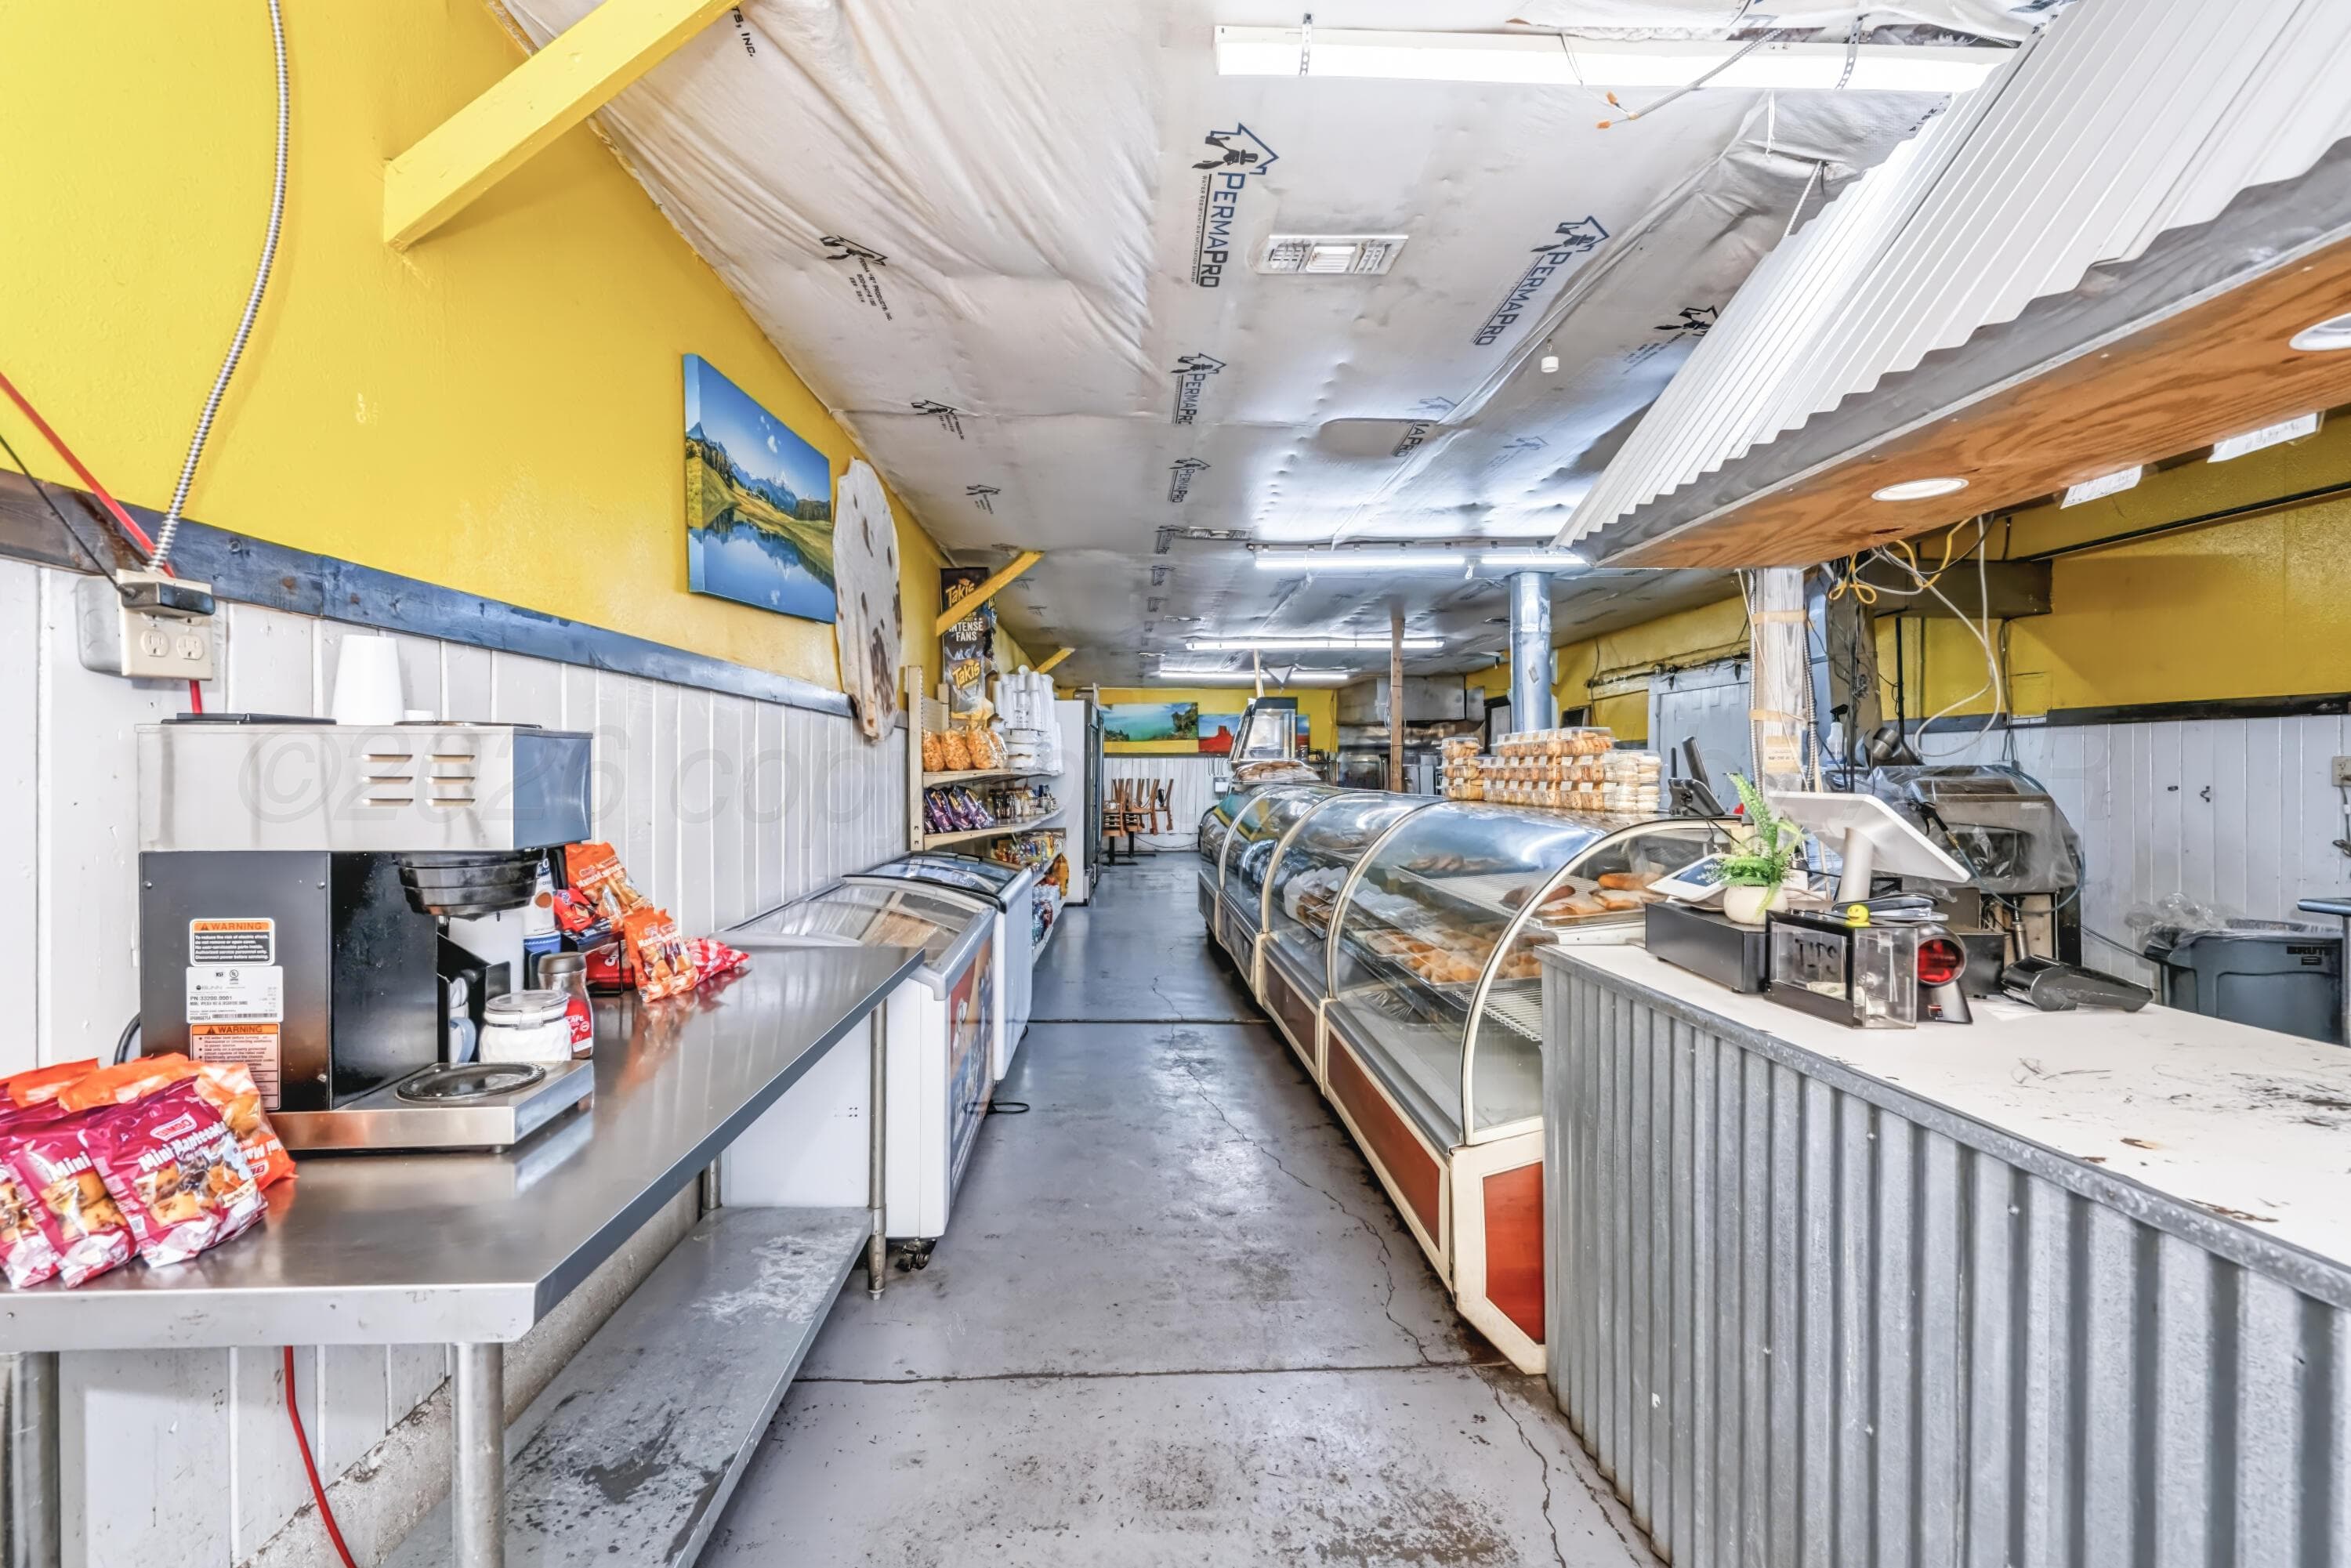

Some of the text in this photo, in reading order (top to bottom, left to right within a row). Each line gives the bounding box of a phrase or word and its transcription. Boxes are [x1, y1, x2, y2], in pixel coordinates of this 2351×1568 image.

[741, 32, 755, 56] INC.
[1199, 172, 1246, 288] PERMAPRO
[1474, 252, 1572, 346] PERMAPRO
[955, 632, 977, 642] FANS
[951, 661, 980, 690] Takis
[212, 922, 262, 931] WARNING
[137, 1143, 176, 1172] Mini
